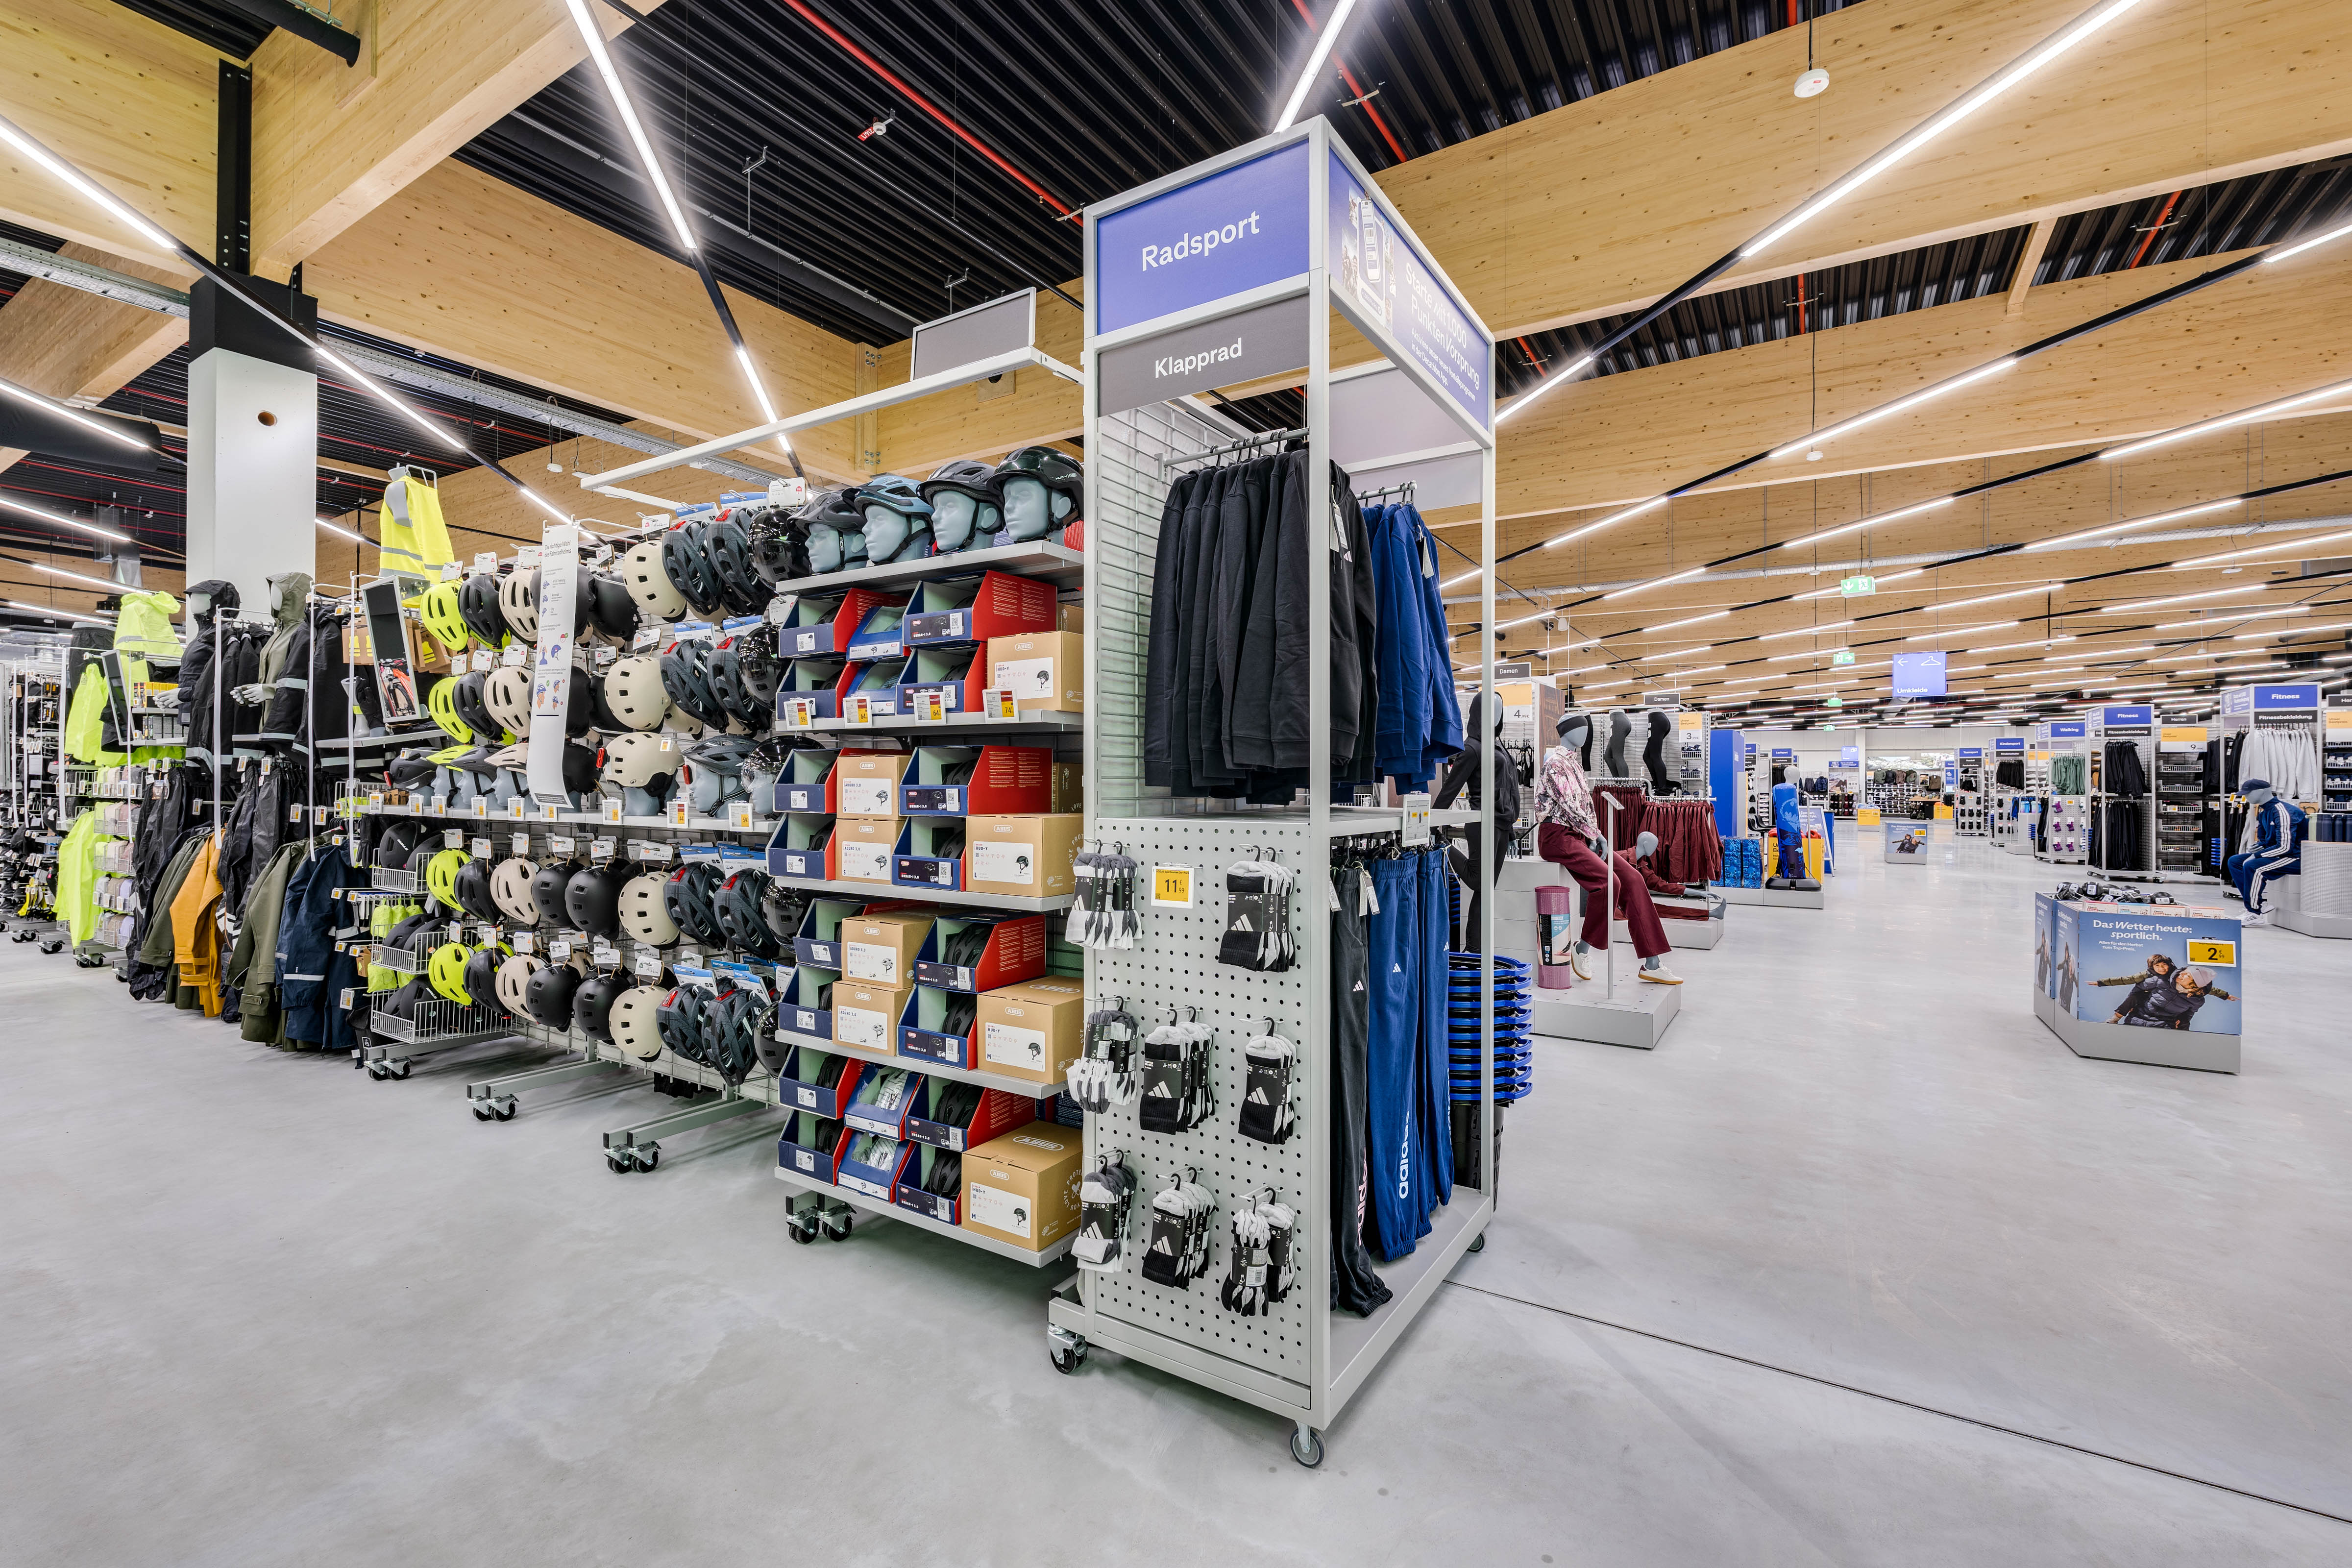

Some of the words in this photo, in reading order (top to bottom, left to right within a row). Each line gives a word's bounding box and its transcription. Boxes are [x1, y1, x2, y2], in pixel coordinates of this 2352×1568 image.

[1142, 211, 1260, 271] Radsport
[1406, 262, 1432, 306] Starte
[1434, 300, 1447, 326] mit
[1447, 307, 1467, 348] 1.000
[1412, 294, 1446, 350] Punkten
[1446, 338, 1480, 391] Vorsprung
[1155, 337, 1243, 378] Klapprad
[1422, 349, 1440, 377] Decathlon
[1412, 328, 1429, 353] Aktiviere
[1429, 344, 1439, 360] unser
[1439, 354, 1448, 370] neues
[1448, 361, 1475, 402] Vorteilsprogramm
[1071, 803, 1082, 811] LOVE
[1072, 833, 1084, 845] PROT
[1165, 879, 1177, 893] 11
[2093, 920, 2113, 929] Das
[2115, 921, 2156, 931] Wetter
[2156, 924, 2192, 933] heute:
[2110, 931, 2162, 941] sportlich.
[2207, 948, 2218, 960] 2
[1021, 1138, 1058, 1150] ABUS
[992, 1171, 1007, 1179] ABUS
[1067, 1169, 1083, 1185] PROTE
[1070, 1203, 1080, 1211] YOU
